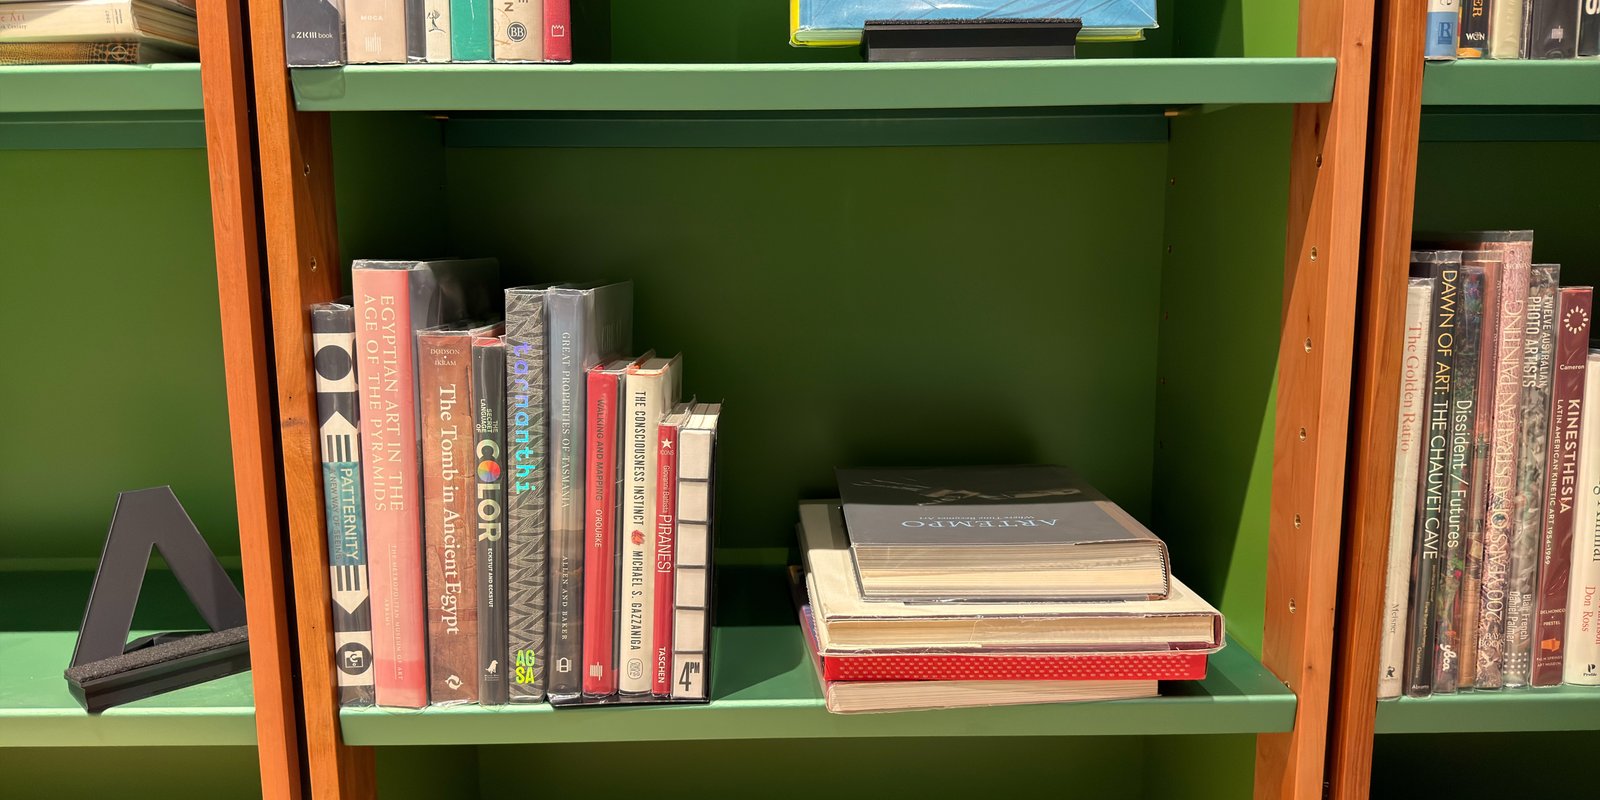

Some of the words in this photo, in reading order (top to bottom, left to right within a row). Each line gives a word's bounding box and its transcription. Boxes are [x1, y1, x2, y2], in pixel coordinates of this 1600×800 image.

[510, 27, 524, 37] BB
[363, 294, 378, 331] AGE
[1439, 270, 1458, 328] DAWN
[1527, 296, 1541, 335] PHOTO
[1542, 295, 1554, 330] TWELVE
[366, 340, 380, 365] OF
[380, 295, 399, 393] EGYPTIAN
[561, 332, 571, 367] GREAT
[1407, 322, 1421, 347] The
[1437, 333, 1453, 357] OF
[1499, 300, 1524, 386] PAINTING
[1404, 356, 1419, 397] Golden
[1522, 338, 1539, 388] ARTISTS
[1538, 332, 1551, 387] AUSTRALIAN
[1559, 363, 1585, 371] Cameron
[368, 374, 382, 410] THE
[1434, 361, 1452, 396] ART:
[385, 400, 400, 433] ART
[439, 384, 457, 421] The
[561, 370, 571, 434] PROPERTIES
[635, 391, 647, 407] THE
[1432, 400, 1449, 431] THE
[1556, 399, 1564, 424] LATIN
[475, 423, 482, 433] OF
[514, 342, 536, 495] tarnanthi
[596, 399, 605, 439] WALKING
[1400, 412, 1416, 452] Ratio
[1452, 400, 1473, 470] Dissident
[387, 443, 401, 462] IN
[440, 425, 459, 481] Tomb
[561, 438, 570, 452] OF
[596, 441, 604, 460] AND
[634, 411, 646, 482] CONSCIOUSNESS
[1493, 391, 1519, 498] AUSTRALIAN
[1553, 426, 1561, 471] AMERICAN
[1559, 399, 1581, 514] KINESTHESIA
[370, 419, 387, 512] PYRAMIDS
[560, 455, 570, 508] TASMANIA
[595, 462, 604, 501] MAPPING
[662, 465, 671, 490] Giovanni
[1426, 435, 1446, 513] CHAUVET
[329, 476, 338, 494] NEW
[389, 472, 403, 511] THE
[443, 486, 459, 503] in
[476, 439, 501, 542] COLOR
[662, 491, 670, 513] Battista
[1549, 472, 1558, 506] KINETIC
[331, 496, 339, 513] WAY
[333, 515, 341, 527] OF
[340, 468, 359, 560] PATTERNITY
[633, 485, 645, 526] INSTINCT
[1447, 489, 1466, 548] Futures
[1490, 501, 1510, 530] OF
[594, 509, 603, 548] O'ROURKE
[902, 519, 1058, 528] ARTEMPO
[1423, 520, 1440, 560] CAVE
[333, 529, 342, 560] SEEING
[443, 507, 461, 580] Ancient
[657, 514, 673, 574] PIRANESI
[1487, 534, 1509, 586] YEARS
[1544, 526, 1553, 565] 1954-1969
[632, 550, 643, 587] MICHAEL
[391, 561, 400, 618] METROPOLITAN
[440, 580, 462, 635] Egypt
[631, 590, 643, 599] S.
[1485, 590, 1504, 623] 200
[1508, 591, 1521, 614] Daniel
[1522, 593, 1532, 611] Blair
[1583, 586, 1596, 606] Don
[630, 602, 643, 651] GAZZANIGA
[1389, 603, 1400, 634] Meisner
[1506, 616, 1519, 644] Palmer
[1519, 613, 1530, 640] French
[1581, 611, 1594, 632] Ross
[515, 649, 536, 667] AG
[515, 667, 535, 684] SA
[658, 646, 667, 684] TASCHEN
